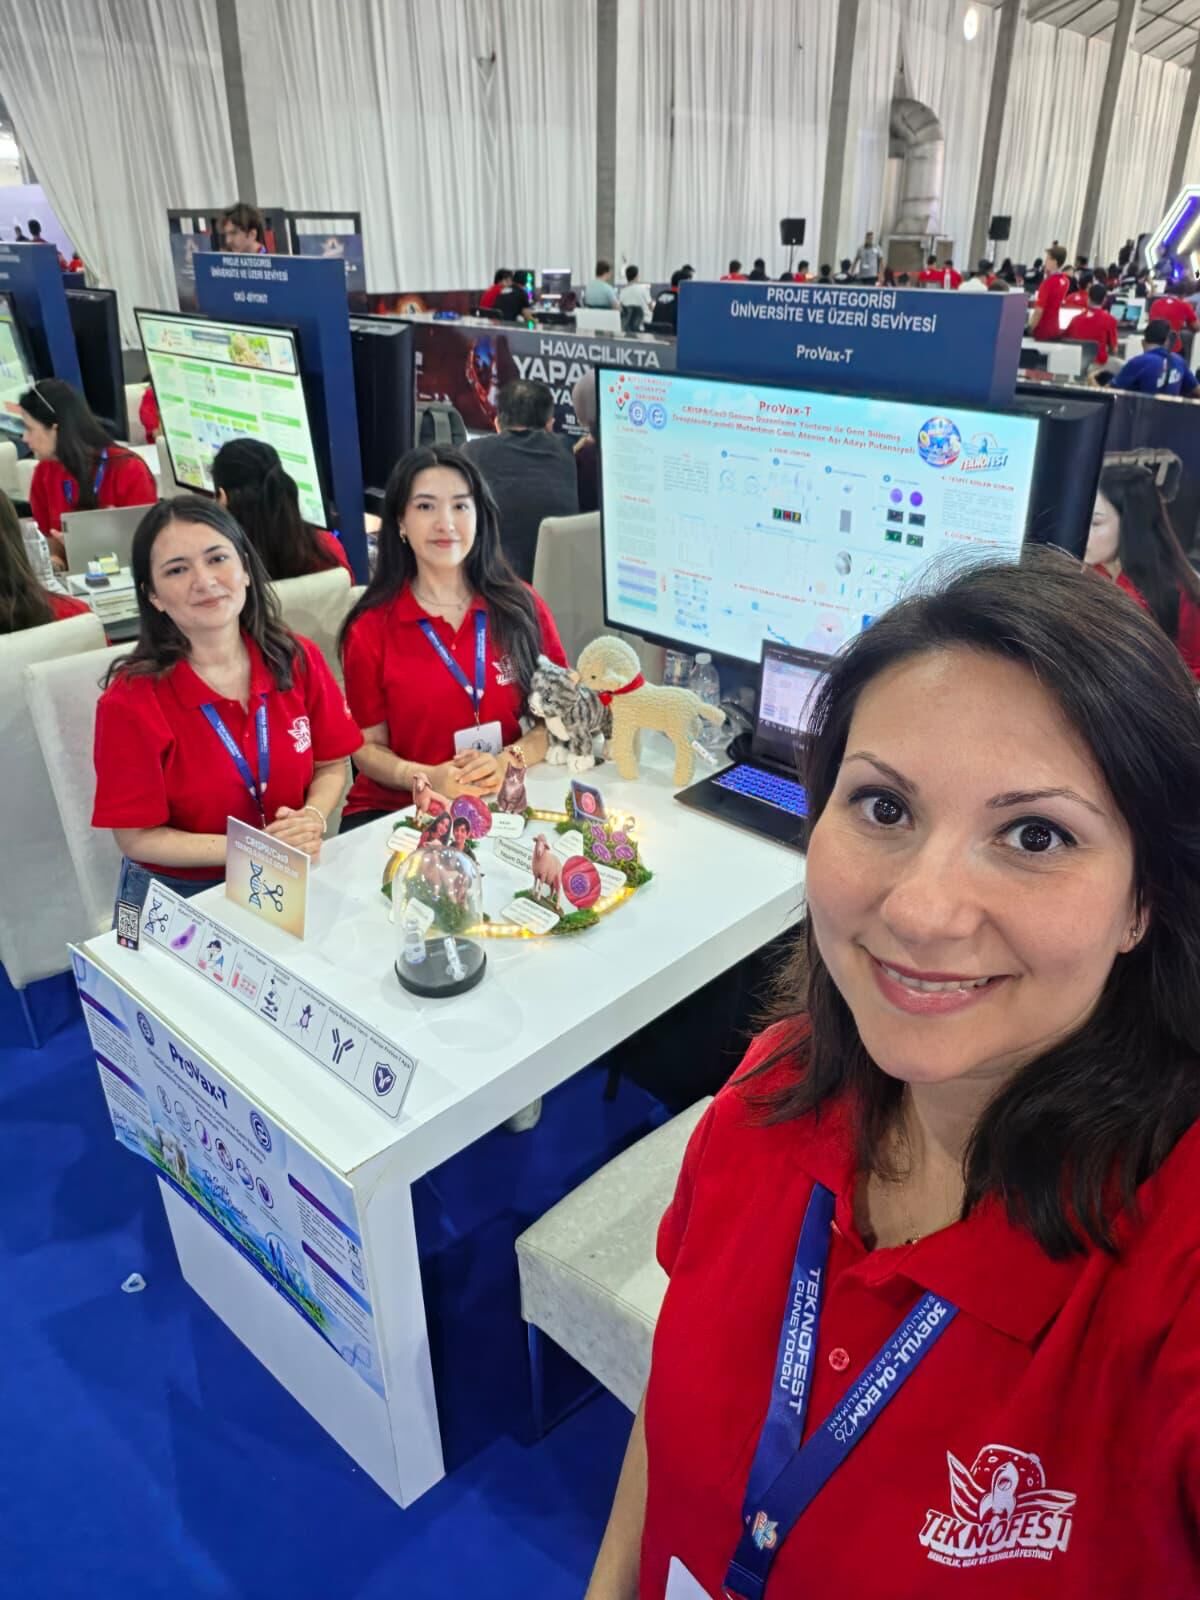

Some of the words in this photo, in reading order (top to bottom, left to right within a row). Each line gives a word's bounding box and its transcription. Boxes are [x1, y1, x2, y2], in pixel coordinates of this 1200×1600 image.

[767, 287, 809, 304] PROJE
[813, 290, 896, 310] KATEGORİSİ
[731, 301, 803, 323] ÜNİVERSİTE
[808, 310, 824, 324] VE
[828, 309, 868, 328] ÜZERİ
[871, 311, 937, 333] SEVİYESİ
[540, 339, 660, 369] HAVACILIKTA
[796, 344, 853, 364] ProVax-T
[759, 400, 812, 417] ProVax-T
[168, 1041, 228, 1110] ProVax-T
[789, 1267, 821, 1416] TEKNOFEST
[875, 1351, 893, 1373] GAP
[918, 1508, 1073, 1558] TEKNOFEST
